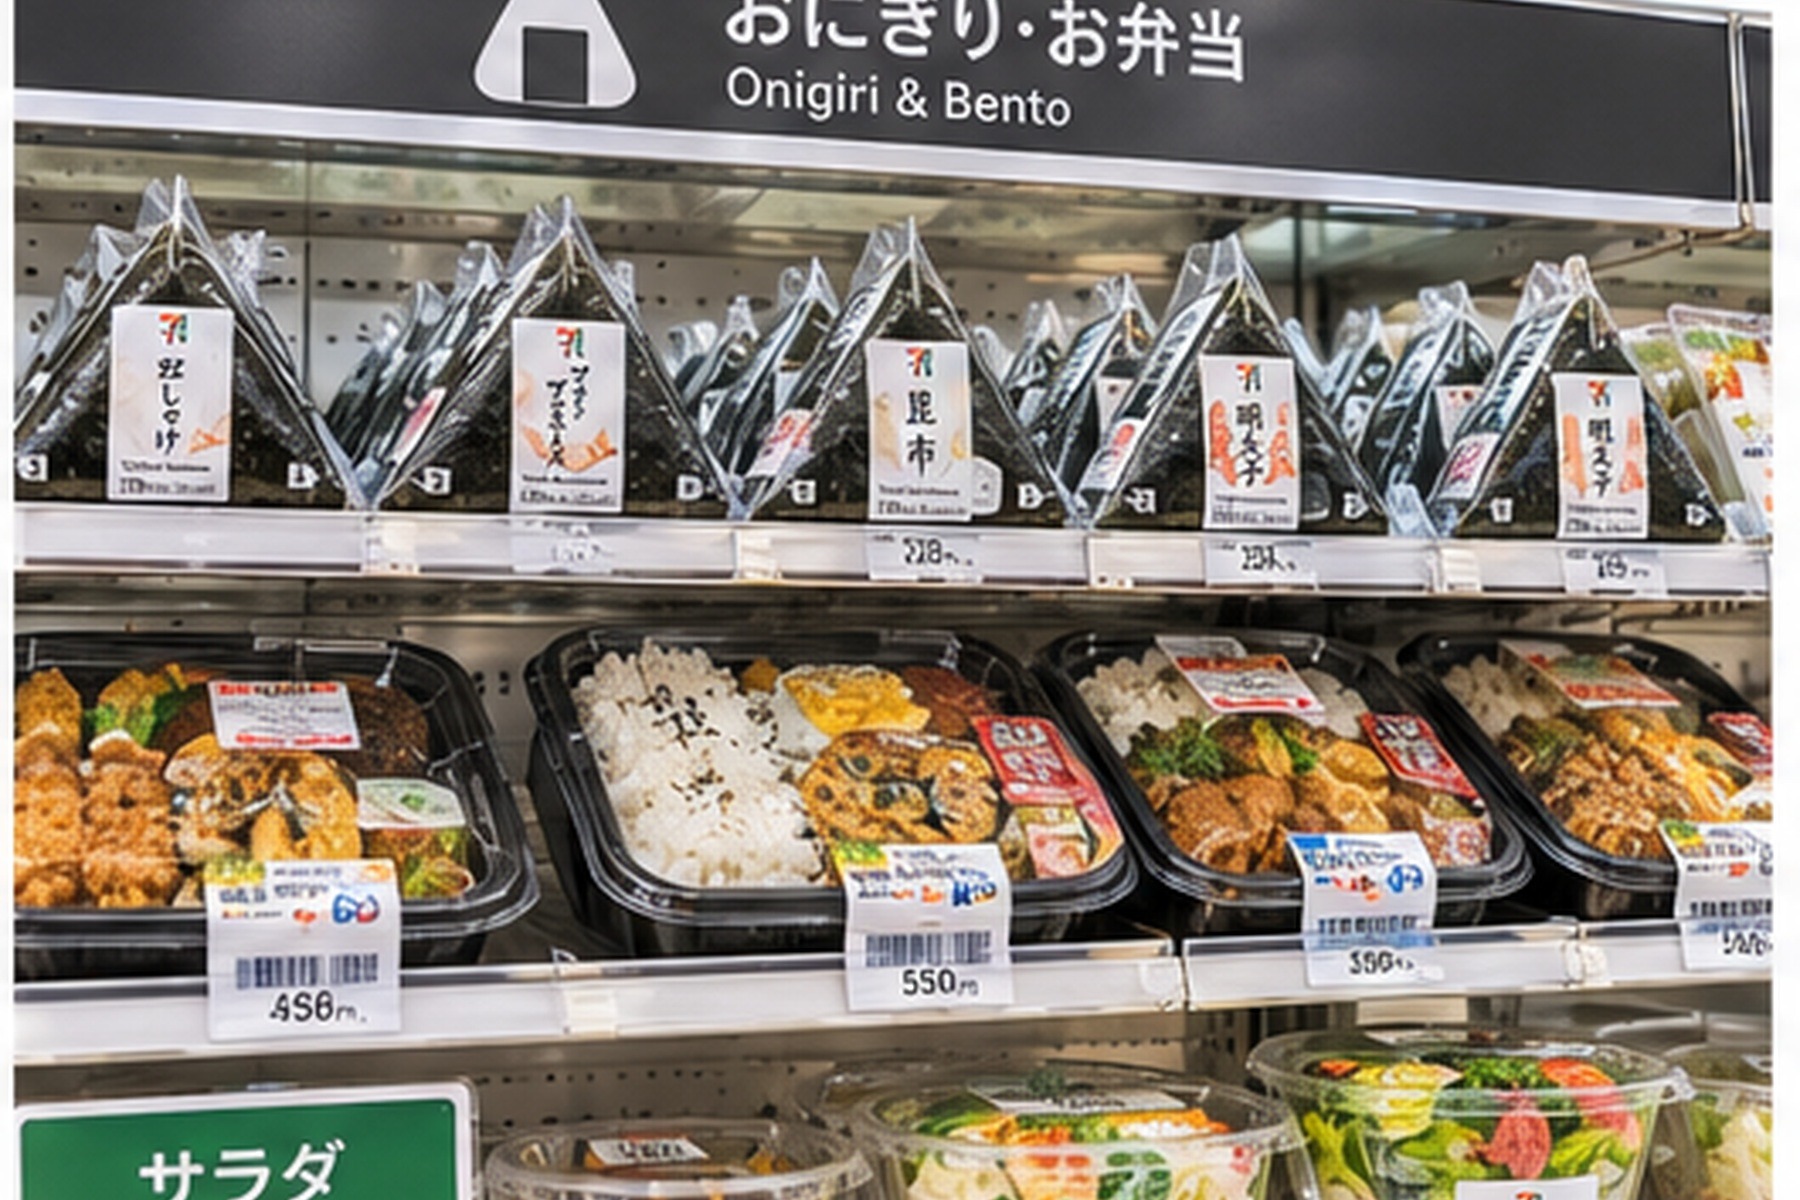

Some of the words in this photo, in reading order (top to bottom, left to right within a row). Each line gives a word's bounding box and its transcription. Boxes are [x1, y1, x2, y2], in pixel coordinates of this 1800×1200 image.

[725, 0, 1244, 83] おにぎり・お弁当
[726, 66, 879, 121] Onigiri
[896, 77, 928, 118] &
[945, 80, 1071, 126] Bento
[139, 1138, 346, 1200] サラダ
